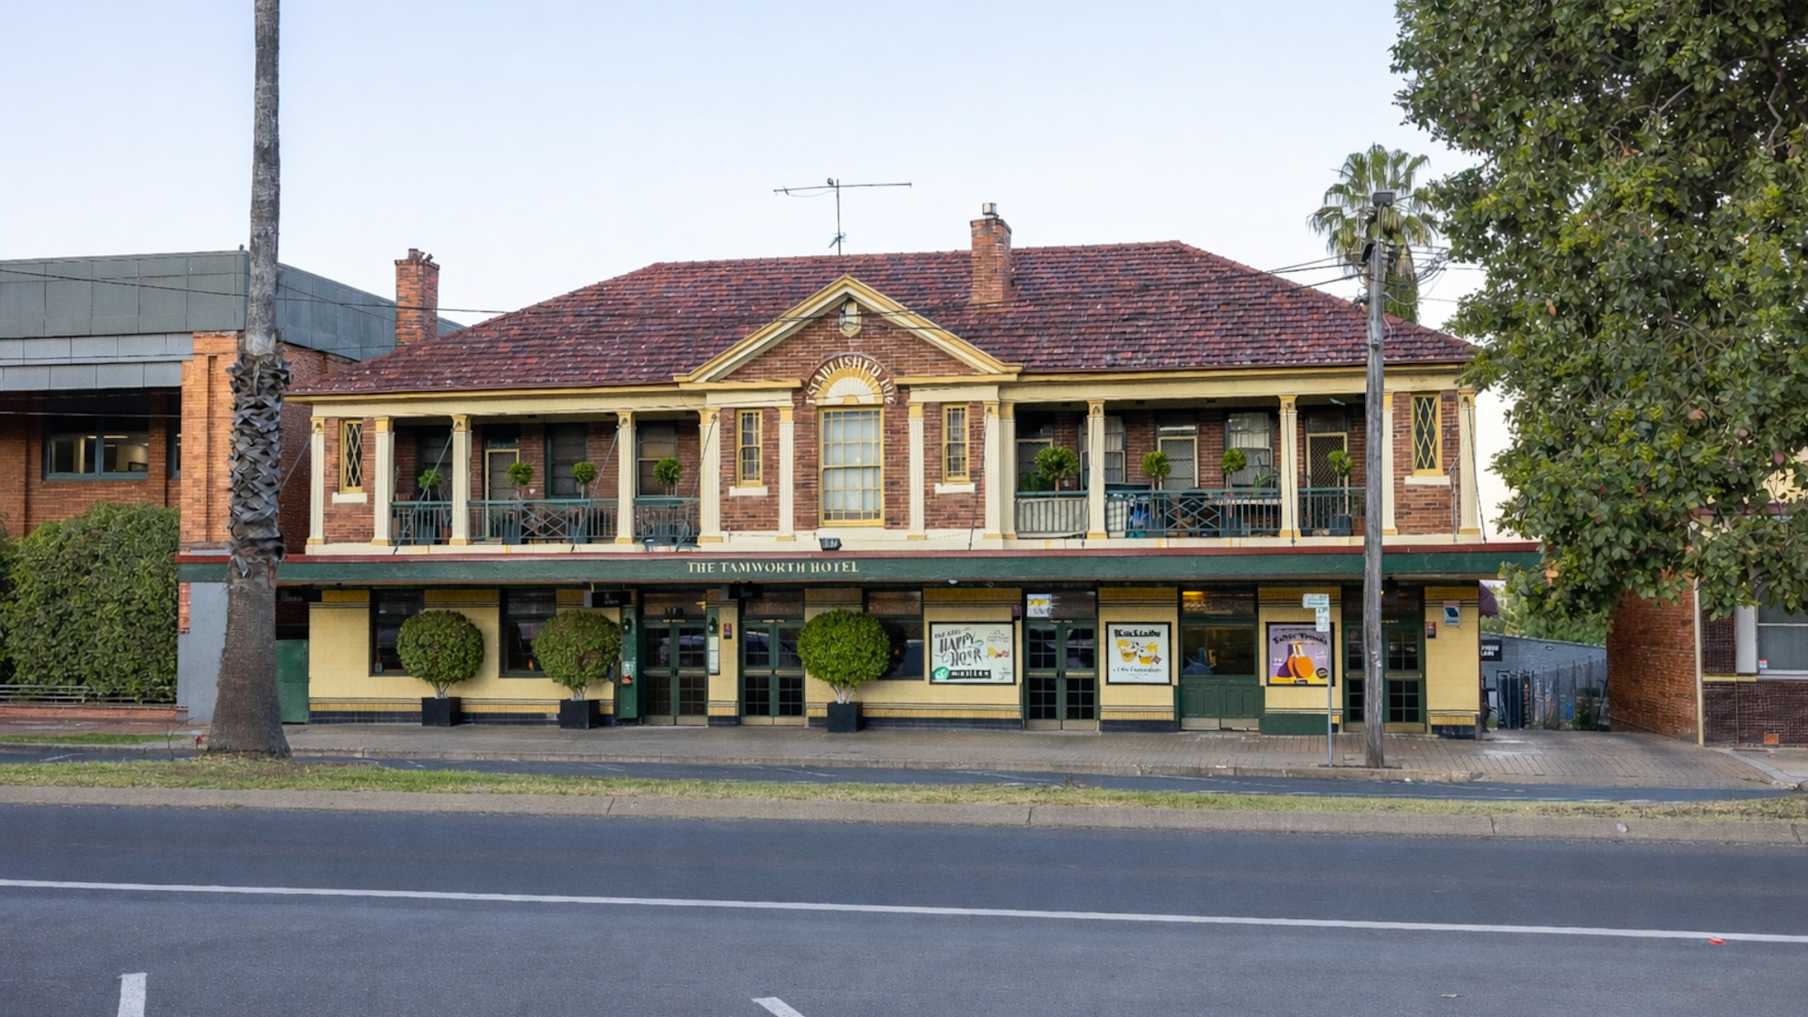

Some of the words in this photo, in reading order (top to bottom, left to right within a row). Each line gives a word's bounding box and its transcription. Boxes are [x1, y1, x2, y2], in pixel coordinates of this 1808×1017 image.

[806, 356, 882, 404] ESTABLISHED
[687, 561, 715, 573] THE
[720, 561, 805, 573] TAMWORTH
[810, 561, 859, 573] HOTEL
[940, 631, 976, 654] HAPPY
[950, 648, 982, 667] HOUR
